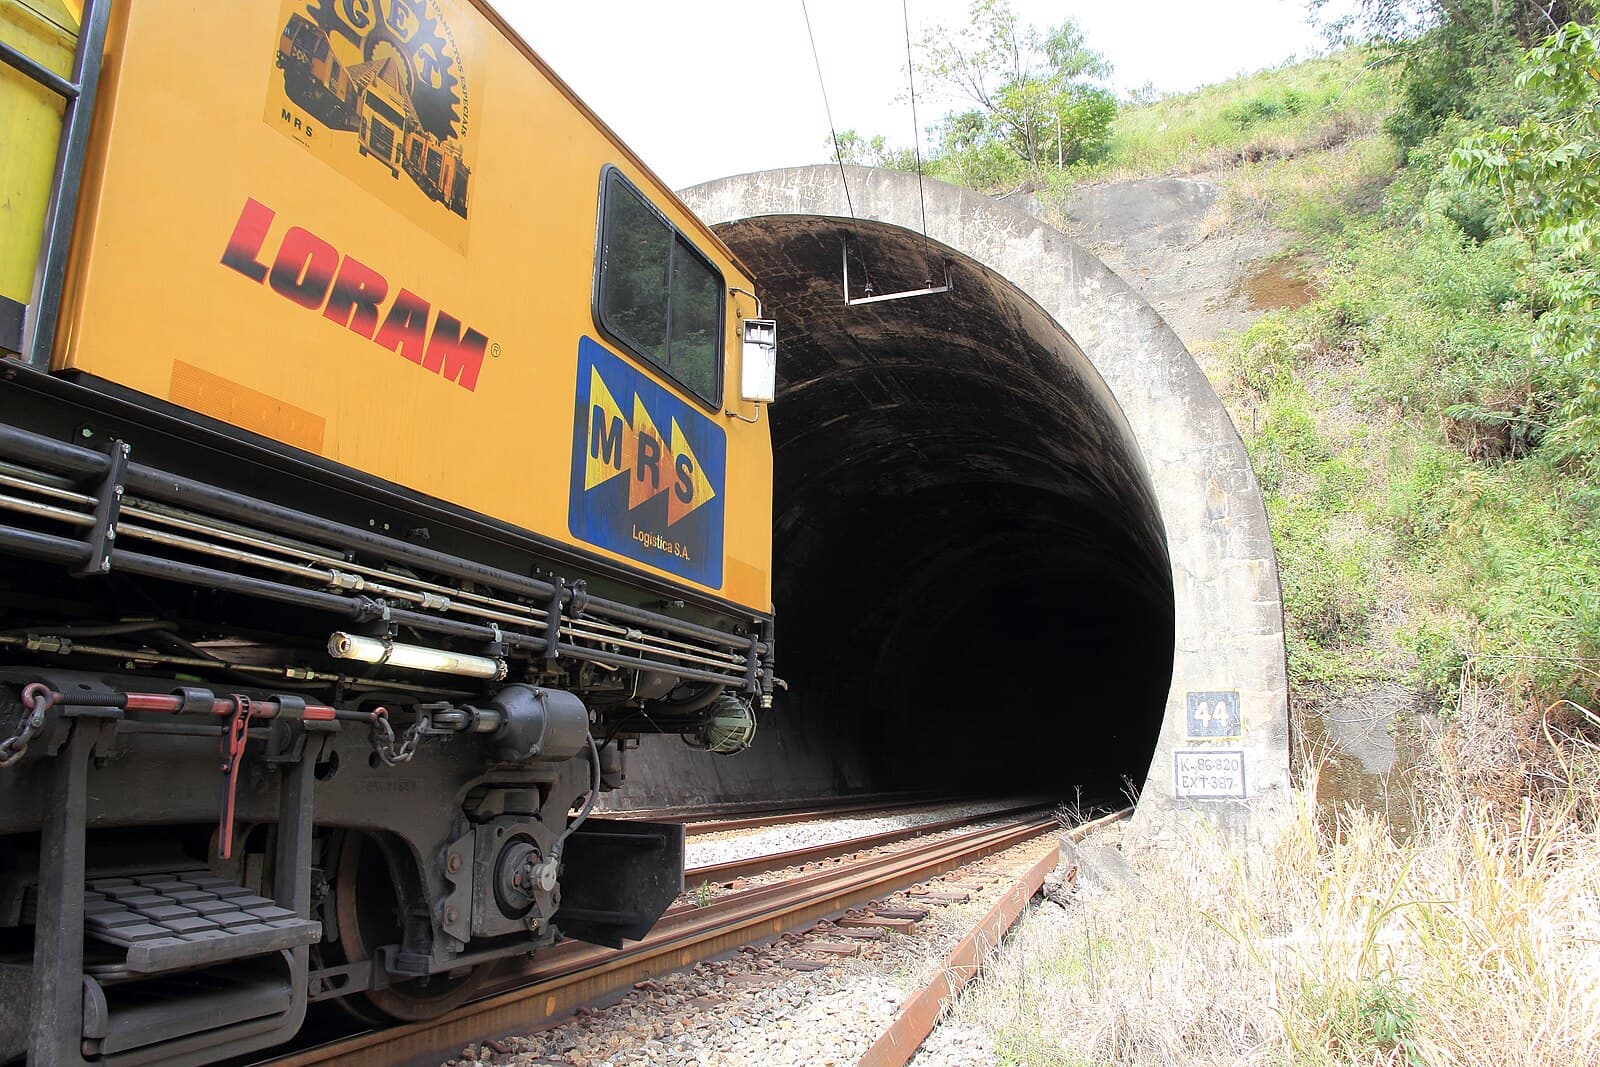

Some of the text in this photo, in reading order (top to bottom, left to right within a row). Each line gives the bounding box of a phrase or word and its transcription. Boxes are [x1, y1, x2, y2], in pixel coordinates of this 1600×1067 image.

[281, 108, 313, 138] MRS
[220, 197, 490, 392] LORAM
[590, 404, 694, 504] MRS
[674, 542, 691, 561] S.A.
[1193, 701, 1230, 728] 44
